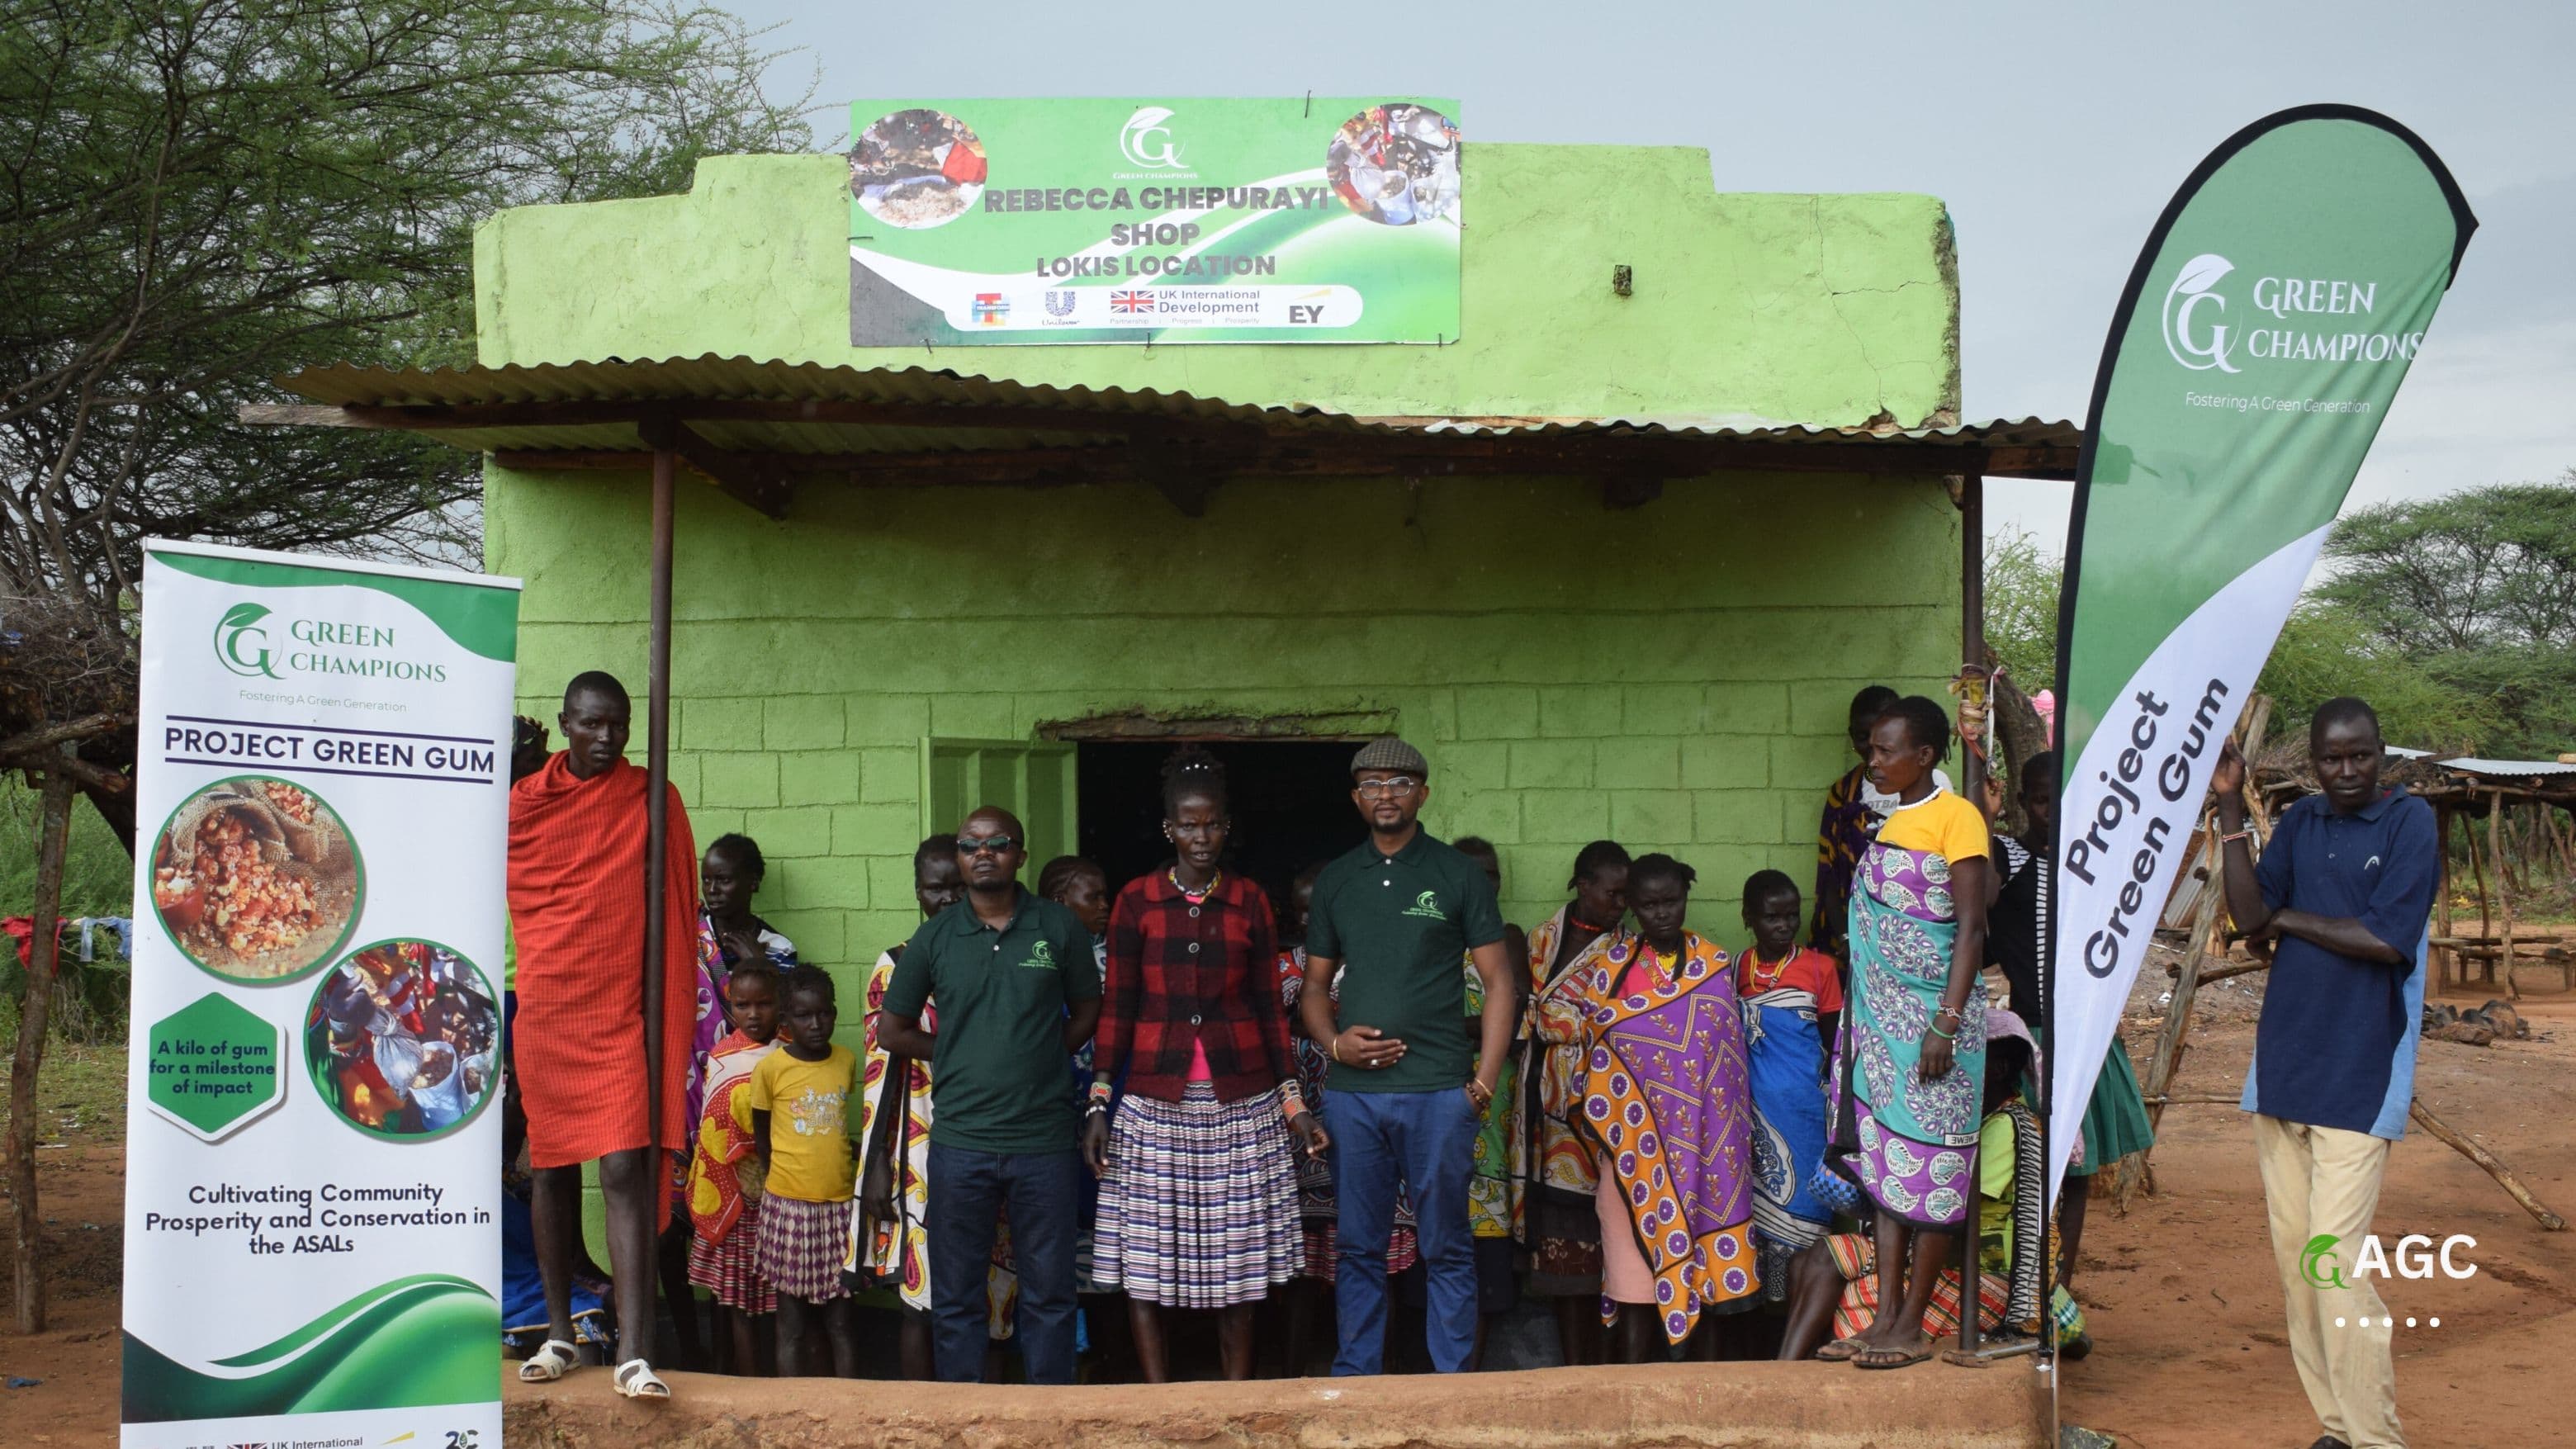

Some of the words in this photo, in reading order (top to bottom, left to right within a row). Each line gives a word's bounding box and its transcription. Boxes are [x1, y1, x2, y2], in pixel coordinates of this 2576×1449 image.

[984, 187, 1134, 212] REBECCA
[1139, 187, 1328, 210] CHEPURAYI
[1110, 223, 1200, 246] SHOP
[1037, 257, 1119, 277] LOKIS
[1125, 256, 1276, 276] LOCATION
[1159, 291, 1177, 300] UK
[1181, 290, 1260, 300] International
[2253, 277, 2378, 319] GREEN
[1159, 301, 1260, 315] Development
[1289, 305, 1324, 324] EY
[2248, 329, 2423, 362] CHAMPIONS
[2186, 391, 2247, 413] Fostering
[2249, 396, 2259, 410] A
[2261, 396, 2300, 412] Green
[2304, 399, 2370, 414] Generation
[291, 619, 395, 647] GREEN
[291, 652, 447, 683] CHAMPIONS
[239, 690, 294, 706] Fostering
[296, 694, 305, 704] A
[307, 695, 341, 708] Green
[343, 698, 407, 713] Generation
[165, 727, 304, 760] PROJECT
[313, 739, 413, 768] GREEN
[424, 746, 495, 773] GUM
[2065, 690, 2169, 886] Project
[2084, 817, 2171, 978] Green
[2158, 678, 2229, 802] Gum
[158, 1041, 170, 1055] A
[175, 1040, 206, 1055] kilo
[210, 1040, 228, 1055] of
[231, 1044, 268, 1058] gum
[149, 1060, 175, 1074] for
[178, 1063, 191, 1074] a
[195, 1060, 275, 1074] milestone
[172, 1080, 191, 1094] of
[194, 1080, 253, 1098] impact
[189, 1184, 312, 1207] Cultivating
[320, 1183, 443, 1205] Community
[145, 1210, 262, 1237] Prosperity
[269, 1208, 312, 1229] and
[320, 1208, 466, 1228] Conservation
[474, 1207, 490, 1225] in
[249, 1236, 285, 1254] the
[292, 1234, 354, 1253] ASALs
[292, 1437, 363, 1449] International
